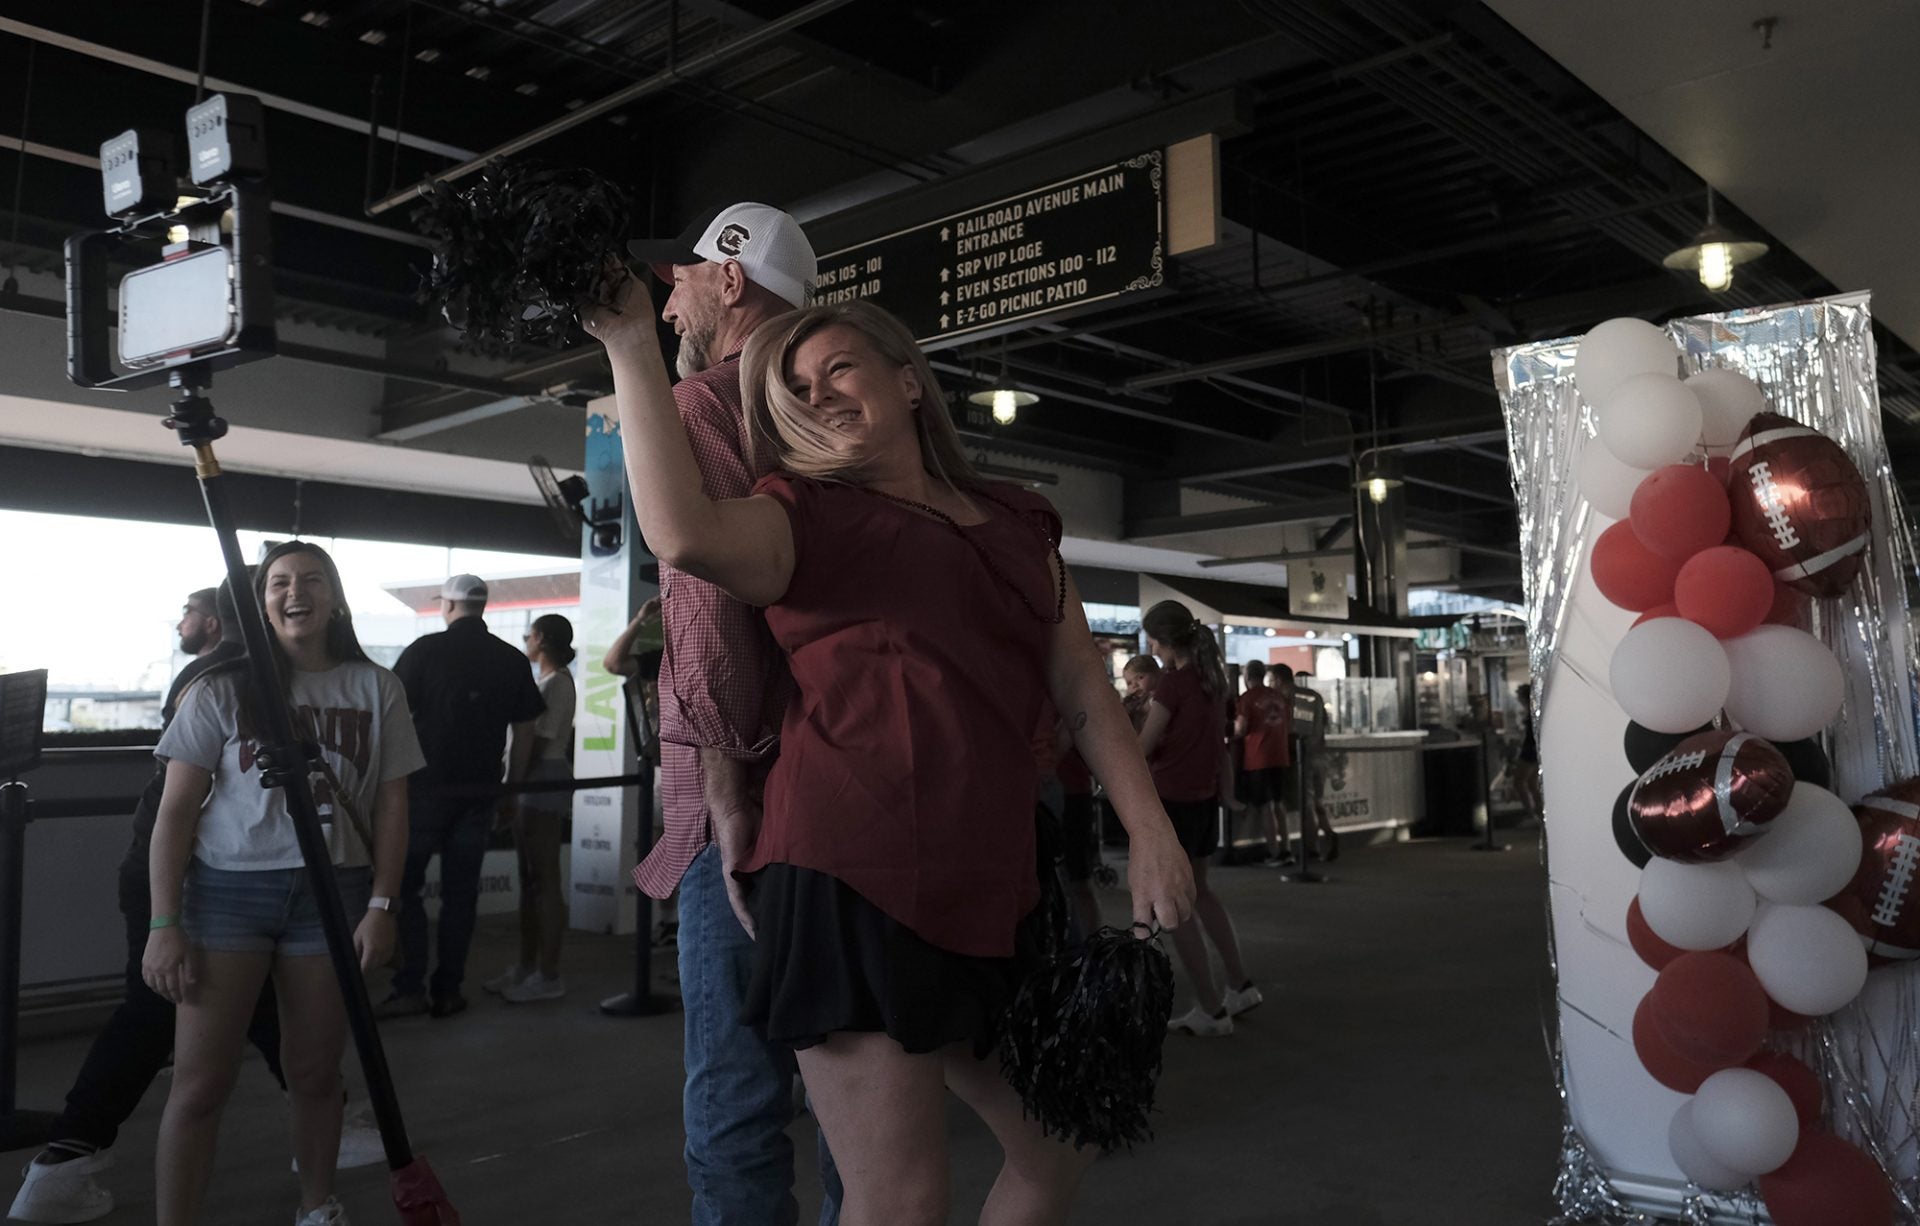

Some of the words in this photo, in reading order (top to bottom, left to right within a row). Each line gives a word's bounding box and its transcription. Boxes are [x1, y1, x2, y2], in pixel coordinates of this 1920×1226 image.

[956, 204, 1024, 238] RAILROAD
[1025, 186, 1081, 217] AVENUE
[1083, 172, 1125, 200] MAIN
[956, 221, 1025, 256] ENTRANCE
[816, 269, 837, 289] ONS
[838, 263, 857, 282] 105
[866, 255, 882, 275] 101
[956, 258, 982, 279] SRP
[984, 251, 1007, 271] VIP
[1009, 240, 1044, 265] LOGE
[956, 278, 990, 302] EVEN
[992, 261, 1057, 293] SECTIONS
[1059, 254, 1084, 275] 100
[1096, 245, 1118, 266] 112
[810, 295, 825, 308] AR
[826, 284, 858, 306] FIRST
[859, 278, 882, 298] AID
[956, 301, 997, 326] E-Z-GO
[1000, 288, 1044, 315] PICNIC
[1046, 277, 1089, 304] PATIO
